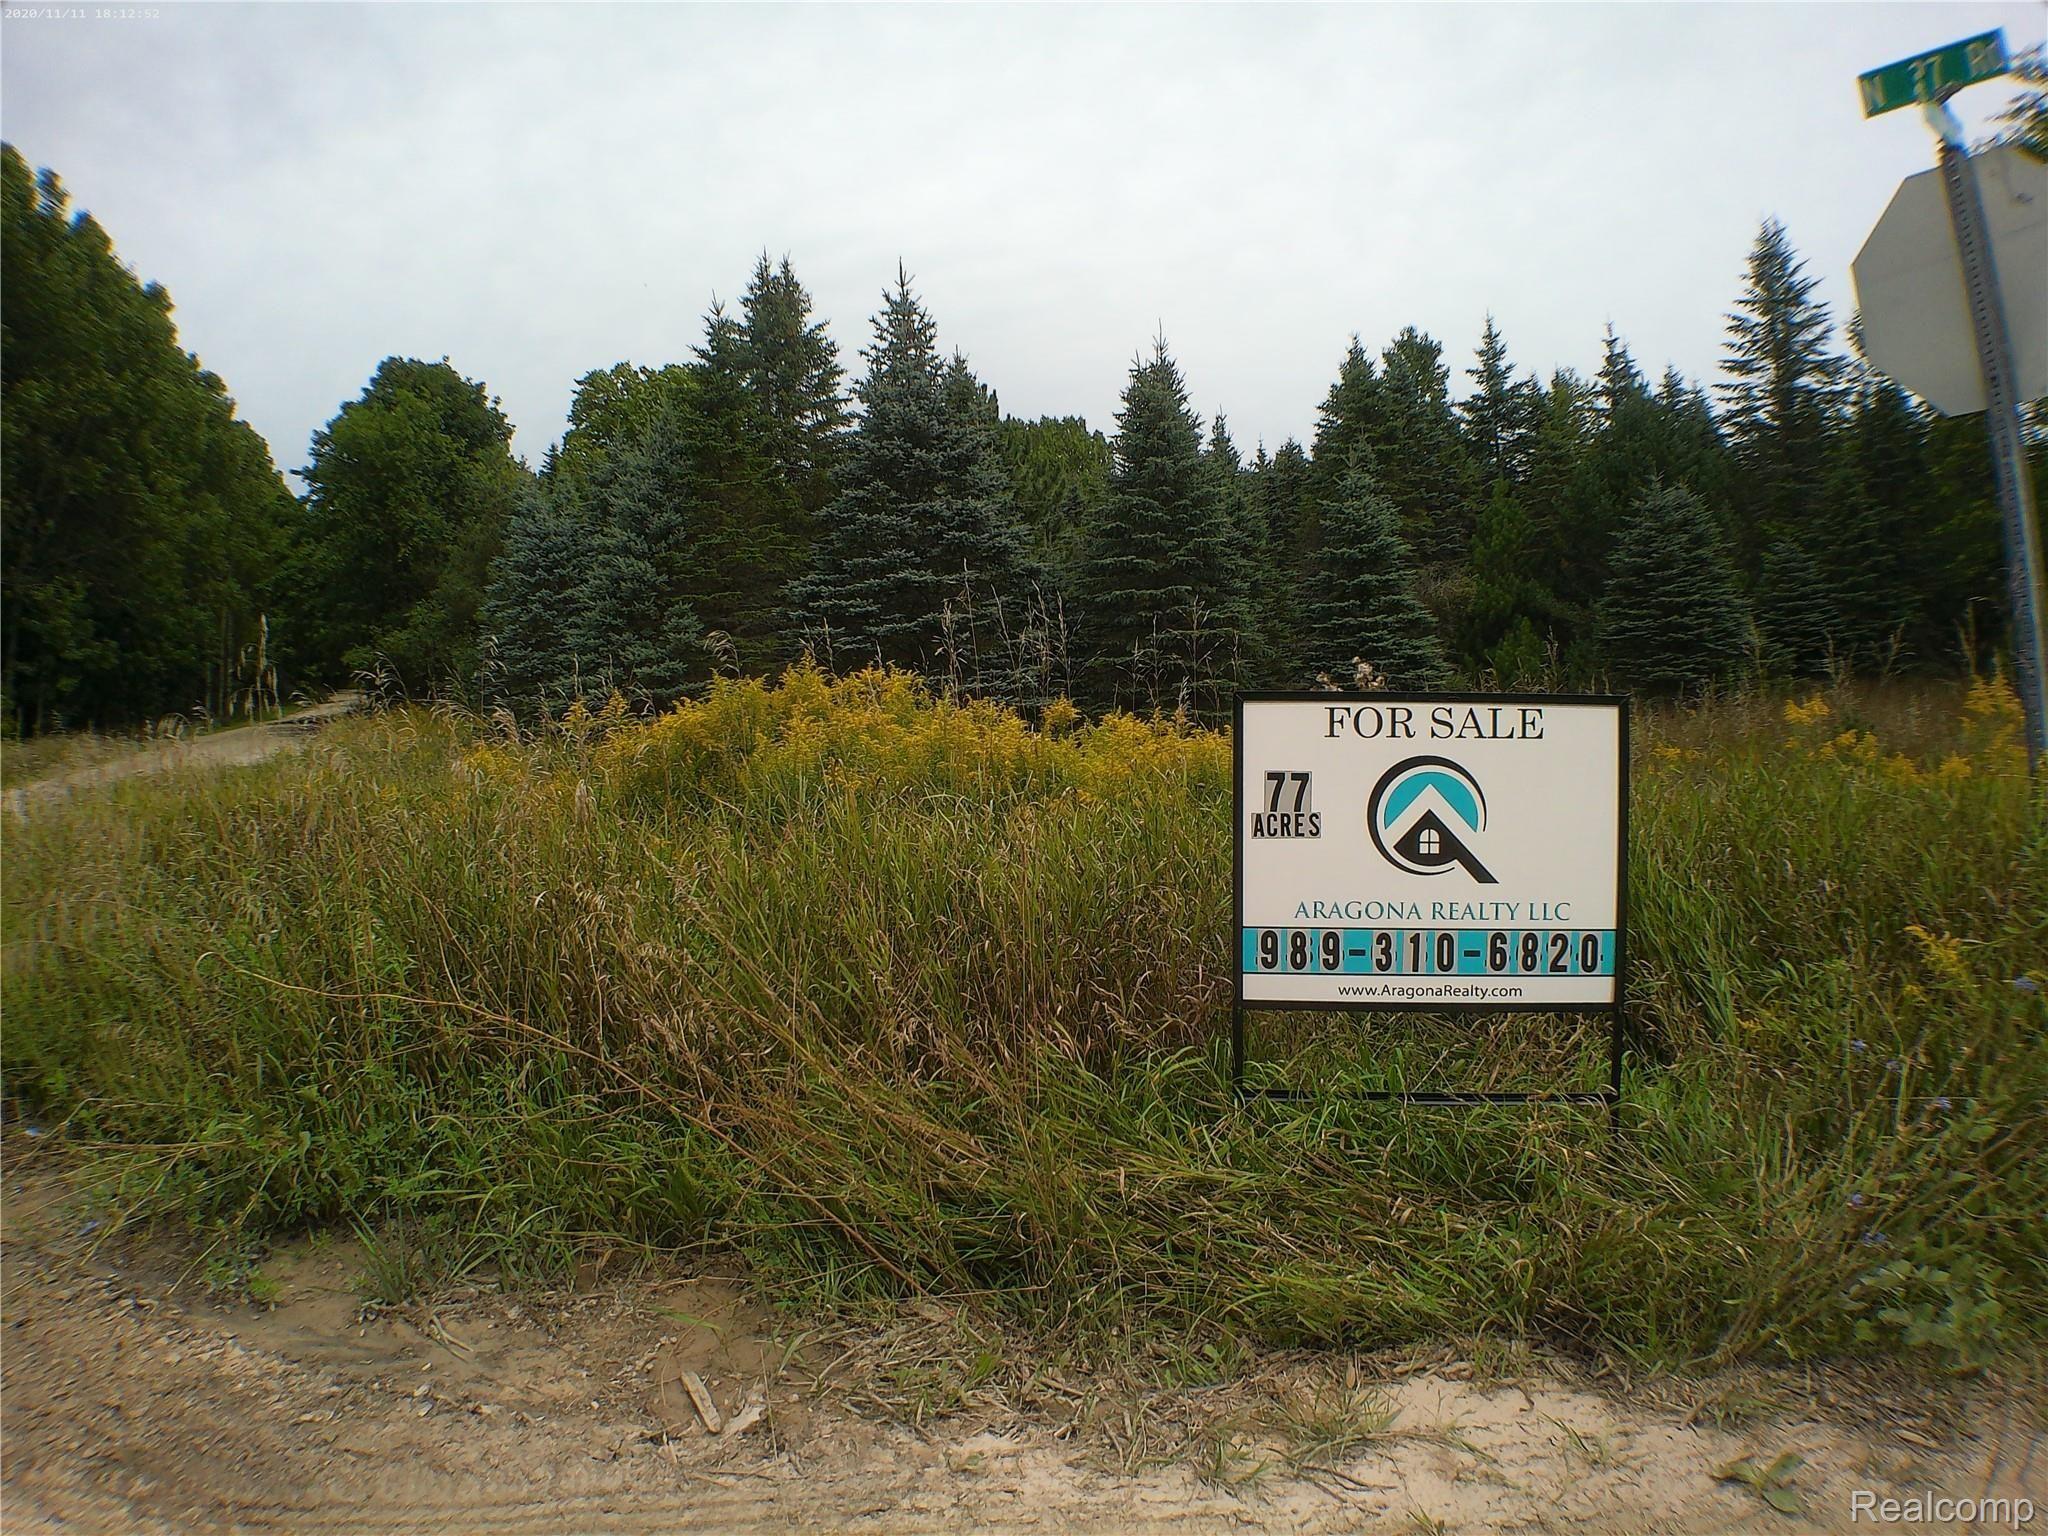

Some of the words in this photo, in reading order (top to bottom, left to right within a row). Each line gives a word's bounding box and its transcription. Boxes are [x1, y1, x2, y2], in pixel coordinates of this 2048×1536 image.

[1861, 75, 1886, 113] N
[1324, 706, 1416, 739] FOR
[1430, 707, 1545, 740] SALE
[1266, 772, 1310, 813] 77
[1253, 812, 1321, 838] ACRES
[1294, 900, 1422, 921] ARAGONA
[1431, 901, 1521, 921] REALTY
[1529, 902, 1572, 922] LLC
[1259, 929, 1600, 973] 989-310-6820
[1338, 983, 1523, 1000] www.AragonaRealty.com
